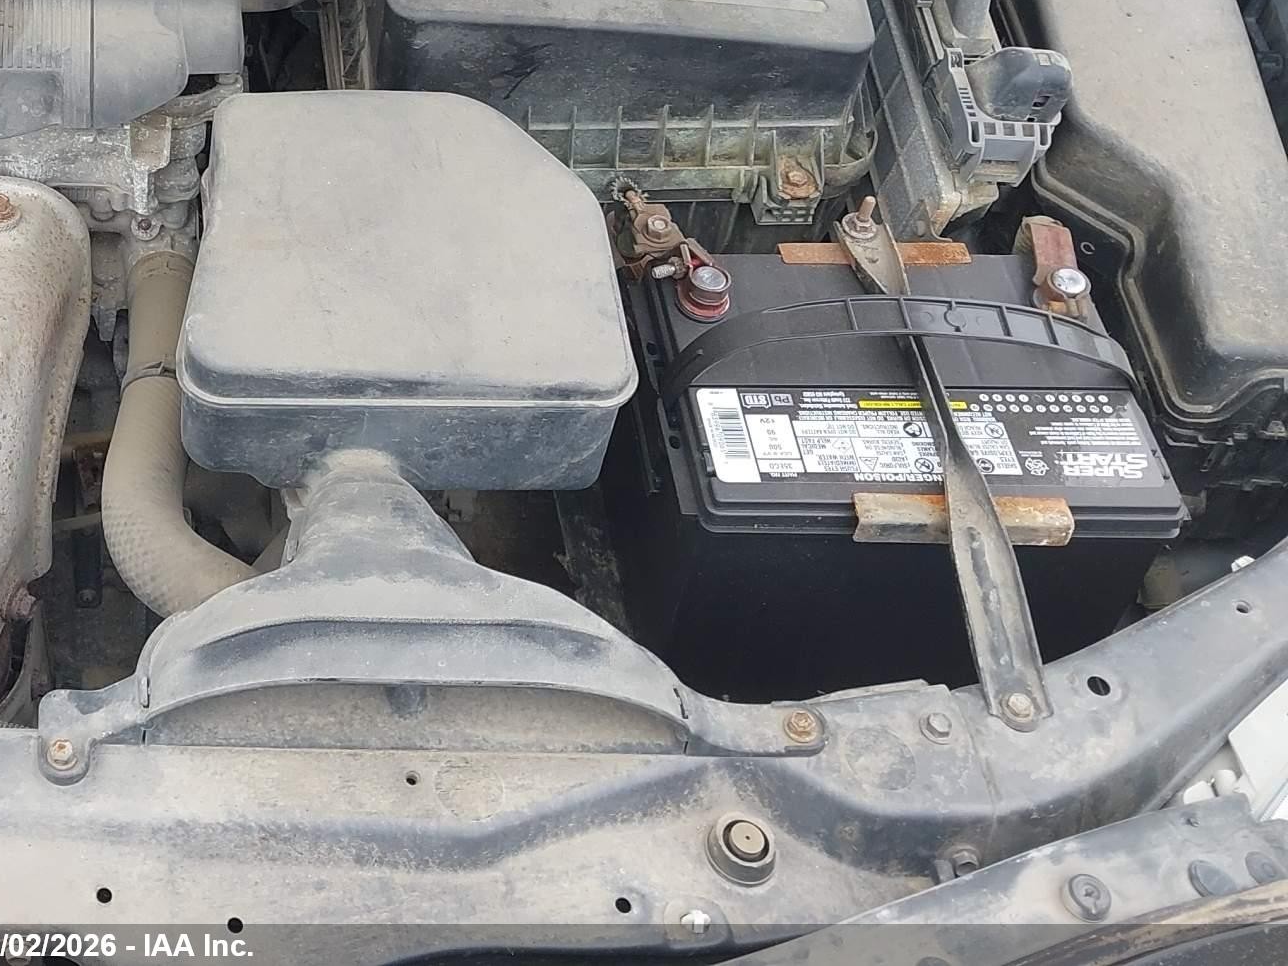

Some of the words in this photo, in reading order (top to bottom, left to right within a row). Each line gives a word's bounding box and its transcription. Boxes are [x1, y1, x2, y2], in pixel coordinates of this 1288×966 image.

[774, 396, 790, 404] Pb
[1059, 453, 1148, 470] START
[855, 473, 944, 482] NGER/POISON
[1063, 465, 1143, 479] SUPER
